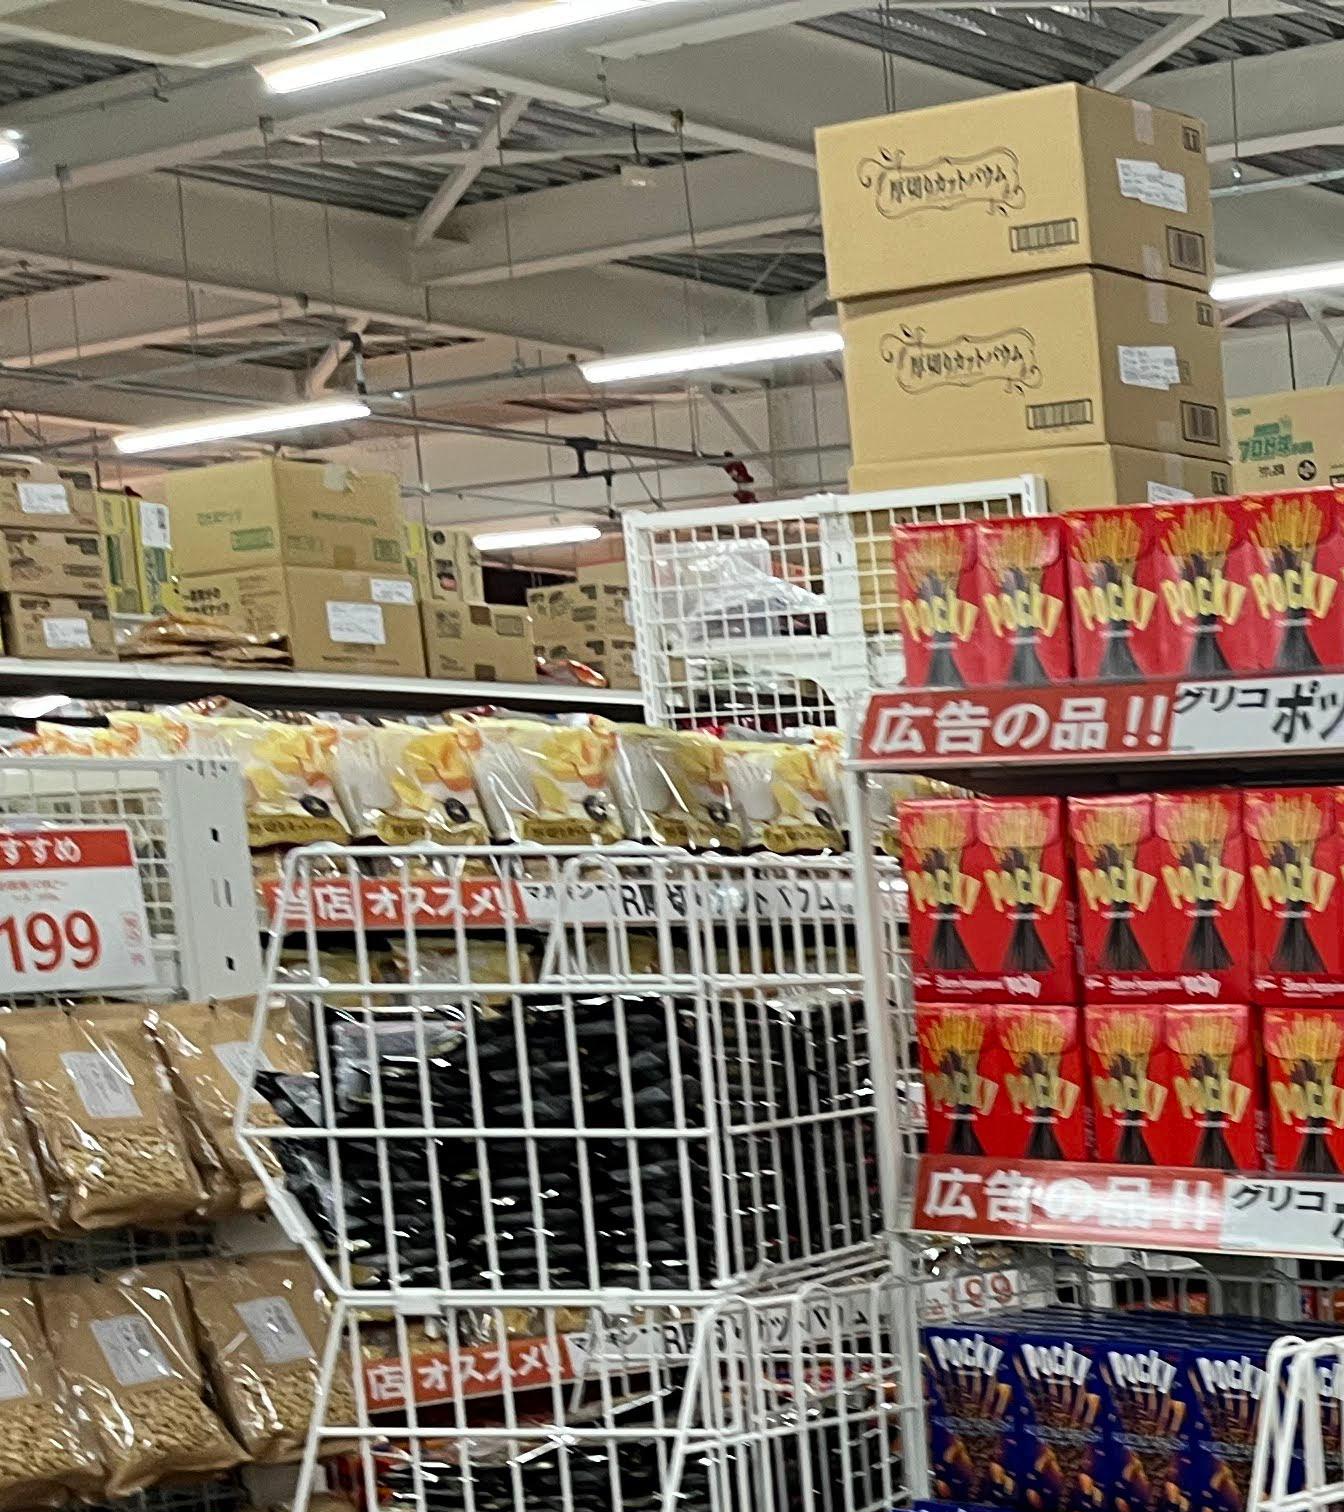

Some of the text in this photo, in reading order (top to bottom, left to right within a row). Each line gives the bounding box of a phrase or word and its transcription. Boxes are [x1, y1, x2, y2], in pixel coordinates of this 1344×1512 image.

[1072, 584, 1156, 630] POCKY
[1160, 577, 1246, 625] POCKY
[1249, 569, 1337, 618] POCKY
[1172, 682, 1269, 715] グリコ
[0, 909, 102, 974] 199
[1229, 1178, 1327, 1213] グリコ
[929, 1334, 1004, 1377] POCKY
[1020, 1340, 1093, 1388] POCKY
[1106, 1349, 1178, 1396] POCKY
